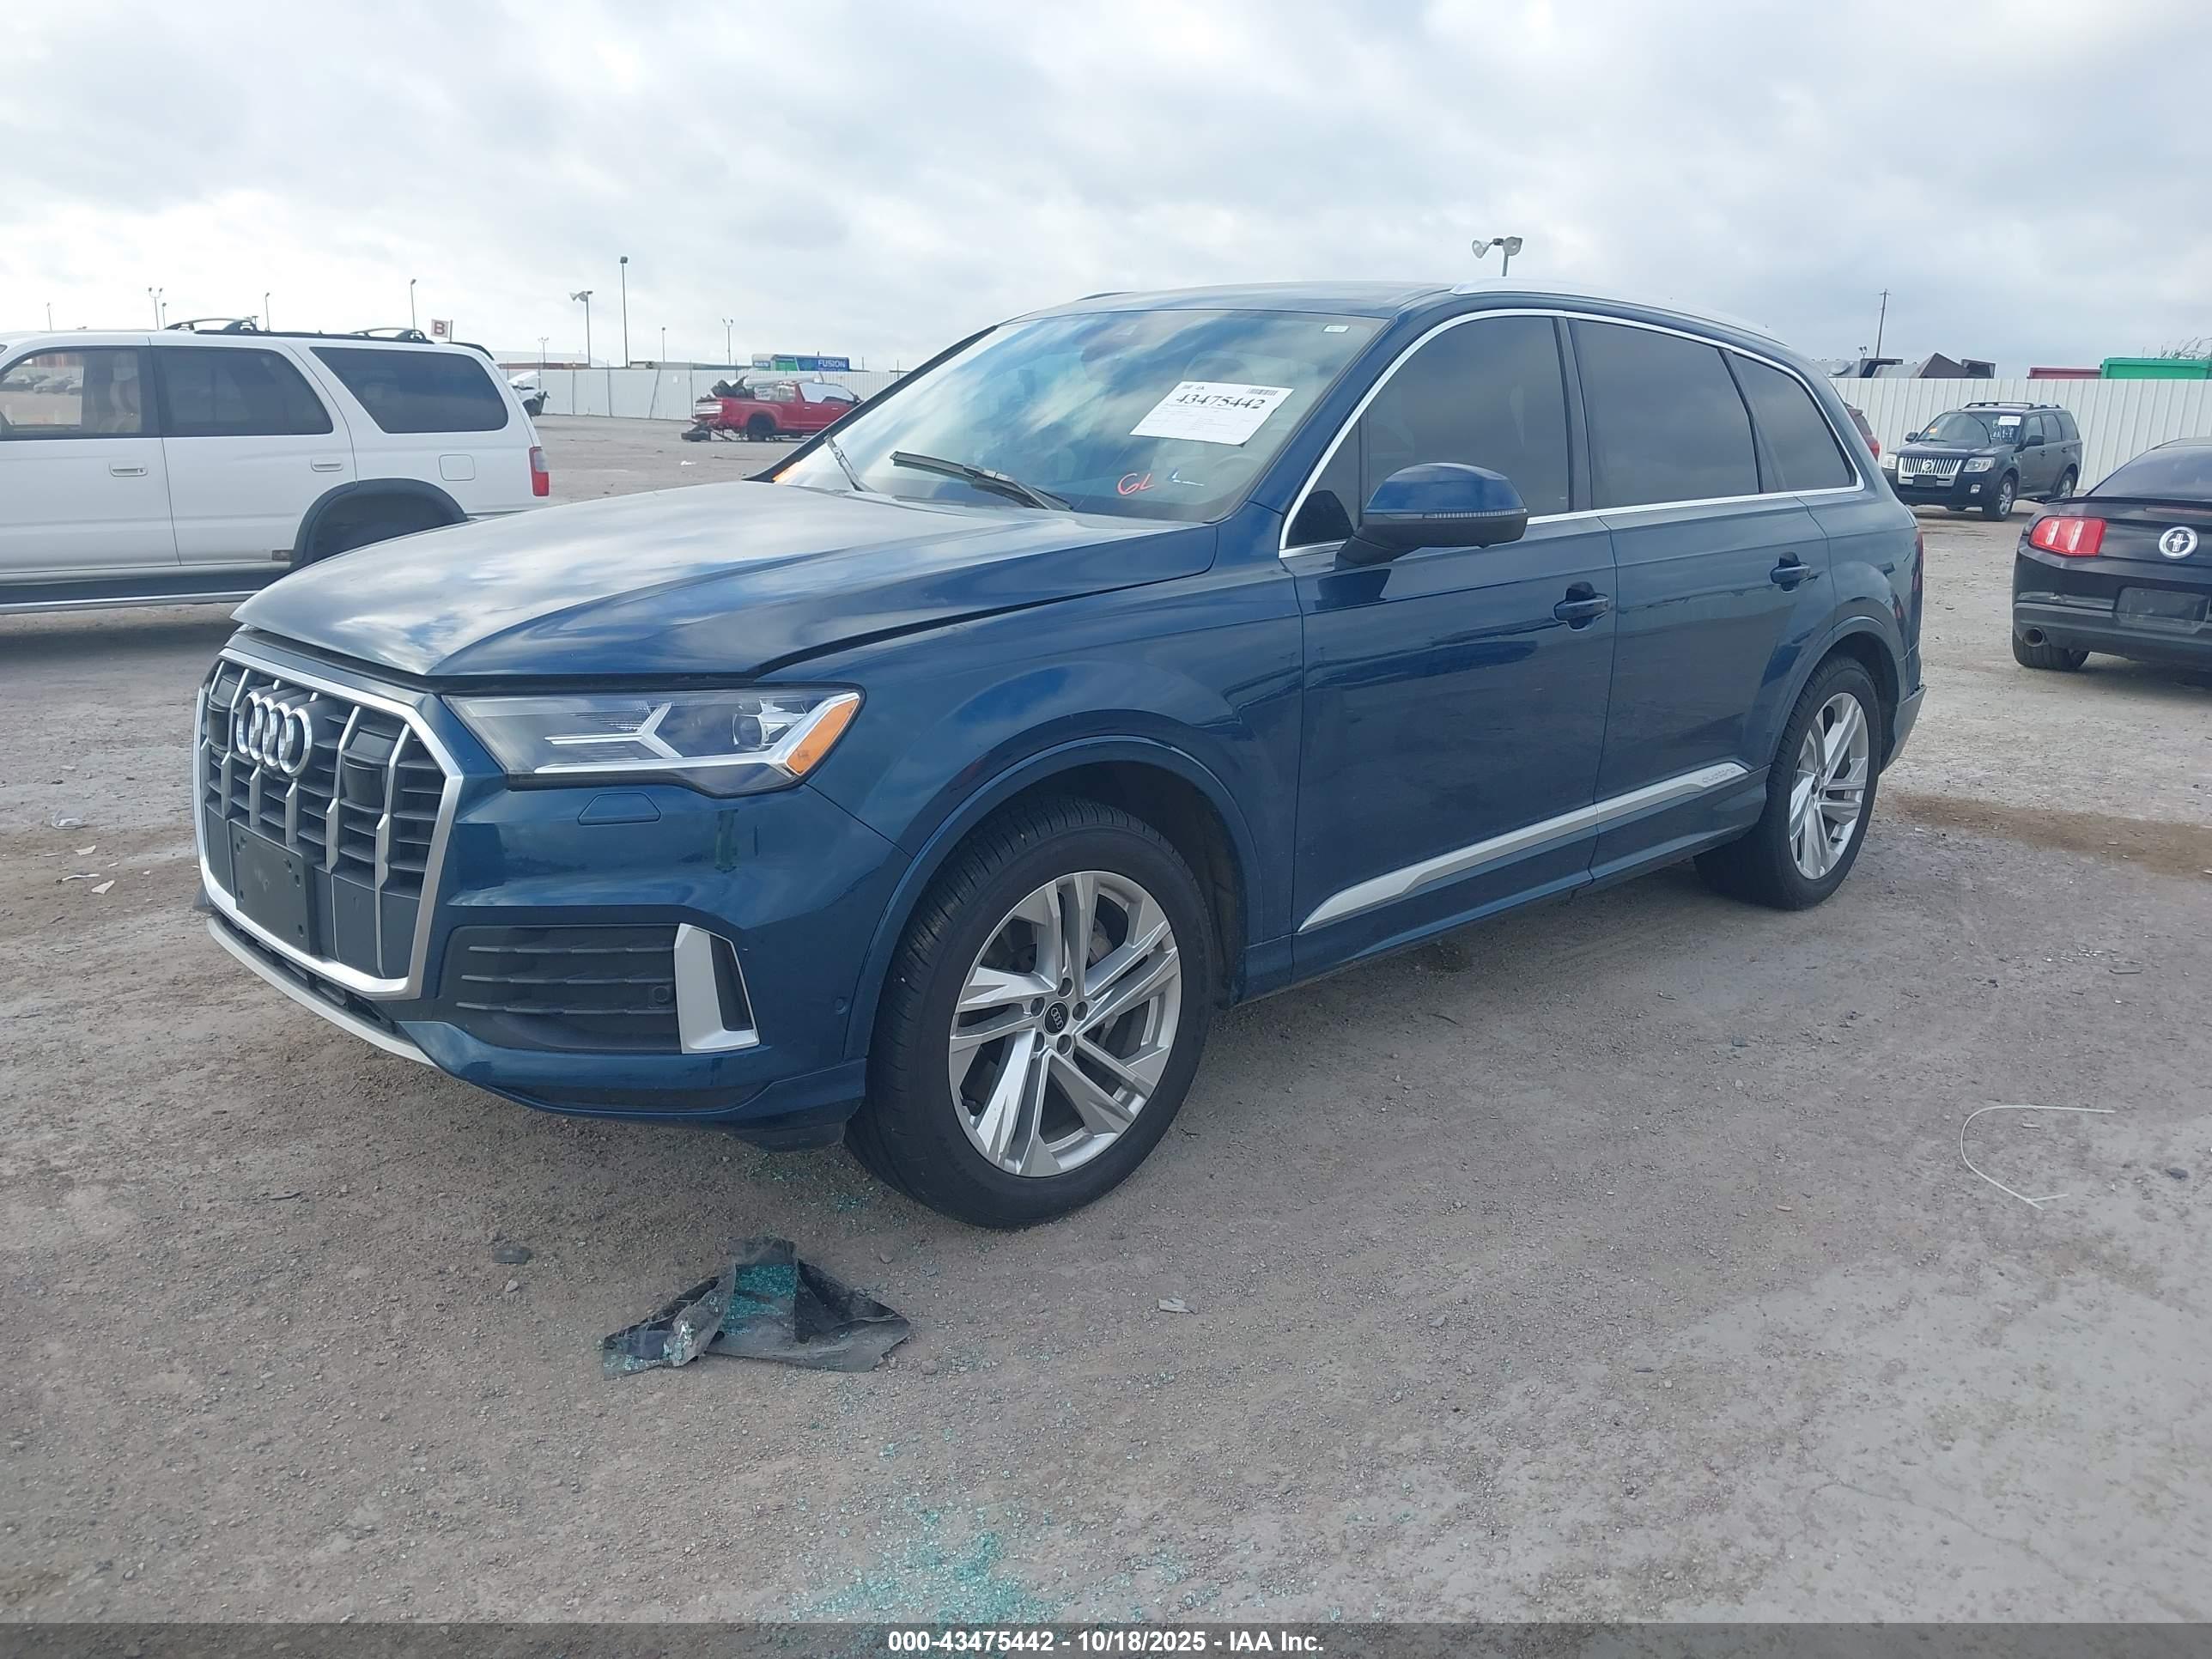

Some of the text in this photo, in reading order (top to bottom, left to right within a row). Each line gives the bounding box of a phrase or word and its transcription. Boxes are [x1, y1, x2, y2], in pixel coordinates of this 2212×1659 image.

[434, 321, 445, 335] B
[817, 360, 846, 368] FUSION
[1176, 393, 1267, 410] 43475442
